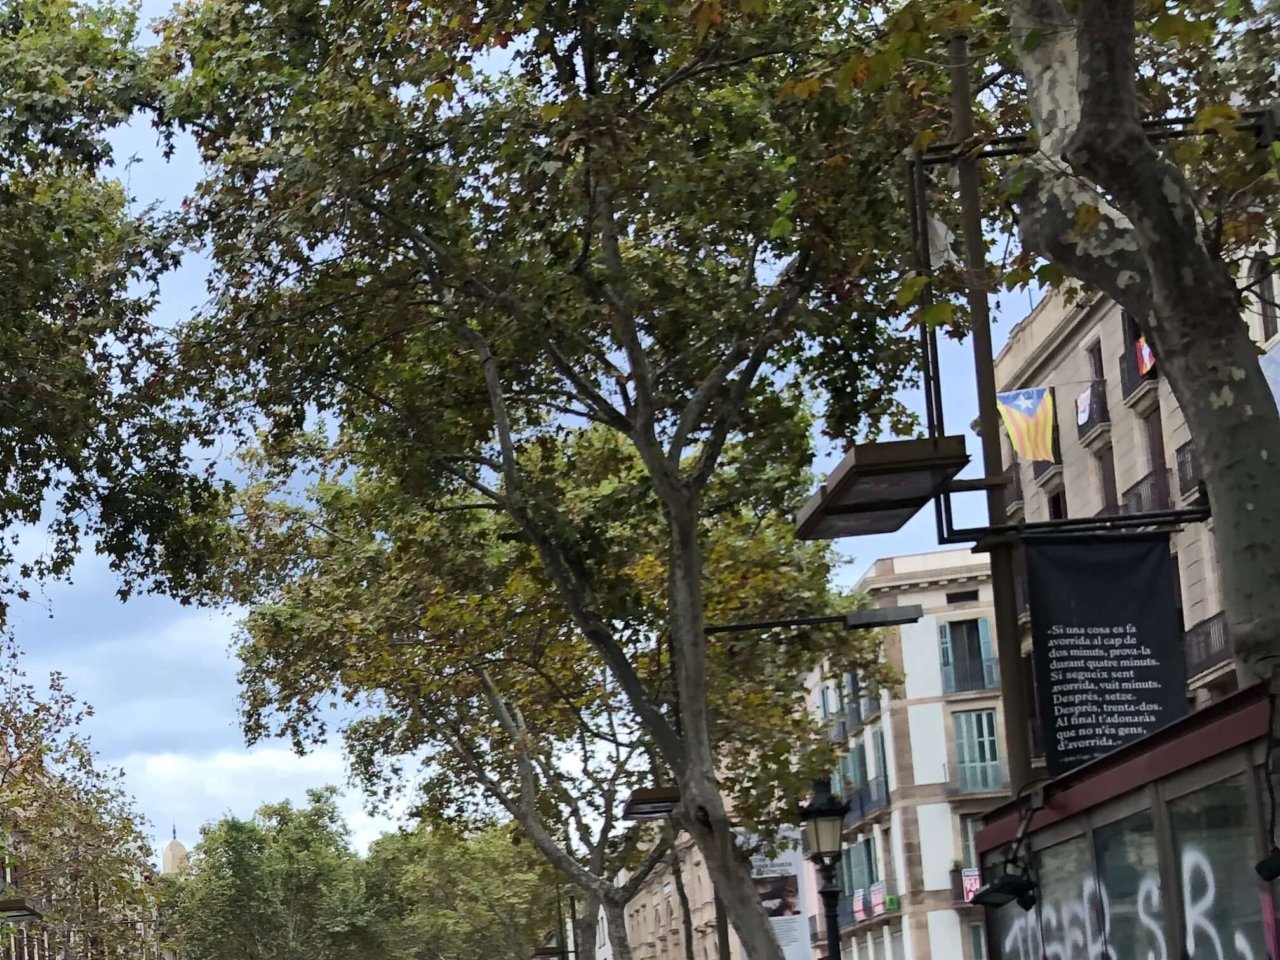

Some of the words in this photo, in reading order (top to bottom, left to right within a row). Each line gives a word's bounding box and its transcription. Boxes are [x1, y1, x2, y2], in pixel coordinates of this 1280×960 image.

[1066, 626, 1085, 634] una
[1126, 623, 1136, 633] fa
[1048, 636, 1091, 647] avorrida
[1104, 638, 1122, 647] cap
[1124, 636, 1137, 644] de
[1048, 648, 1068, 658] dos
[1070, 647, 1108, 657] minuts,
[1109, 646, 1151, 658] prova-la
[1050, 660, 1085, 669] durant
[1087, 659, 1118, 669] quatre
[1120, 658, 1160, 667] minuts.
[1050, 670, 1062, 681] Si
[1066, 669, 1108, 680] segueix
[1111, 670, 1135, 678] sent
[1099, 681, 1119, 690] vuit
[1122, 680, 1162, 689] minuts.
[1103, 702, 1162, 712] trenta-dos.
[1056, 717, 1068, 727] Al
[1071, 714, 1096, 724] final
[1057, 730, 1076, 740] que
[1079, 728, 1093, 736] no
[1118, 726, 1147, 736] gens,
